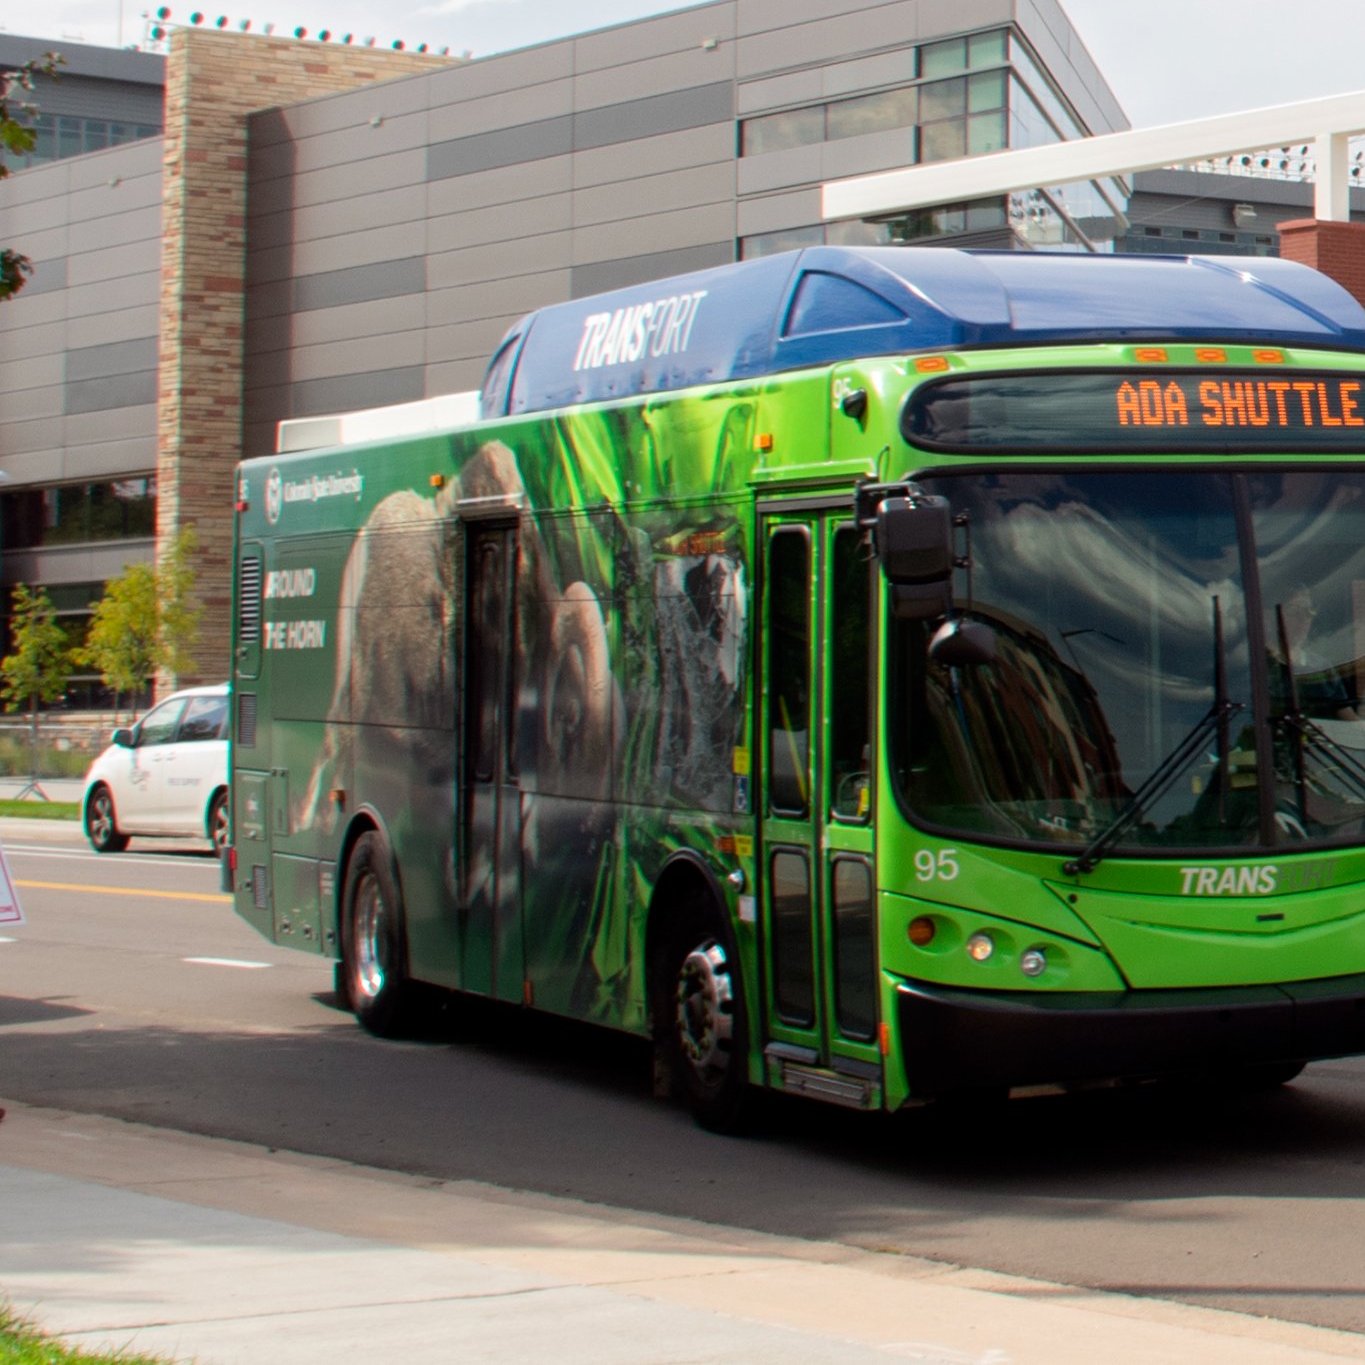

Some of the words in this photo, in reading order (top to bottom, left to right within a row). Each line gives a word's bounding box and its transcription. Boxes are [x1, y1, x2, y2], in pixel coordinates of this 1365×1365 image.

[573, 290, 709, 372] TRANSFORT
[1116, 381, 1189, 426] ADA
[1198, 381, 1365, 427] SHUTTLE
[914, 849, 960, 883] 95
